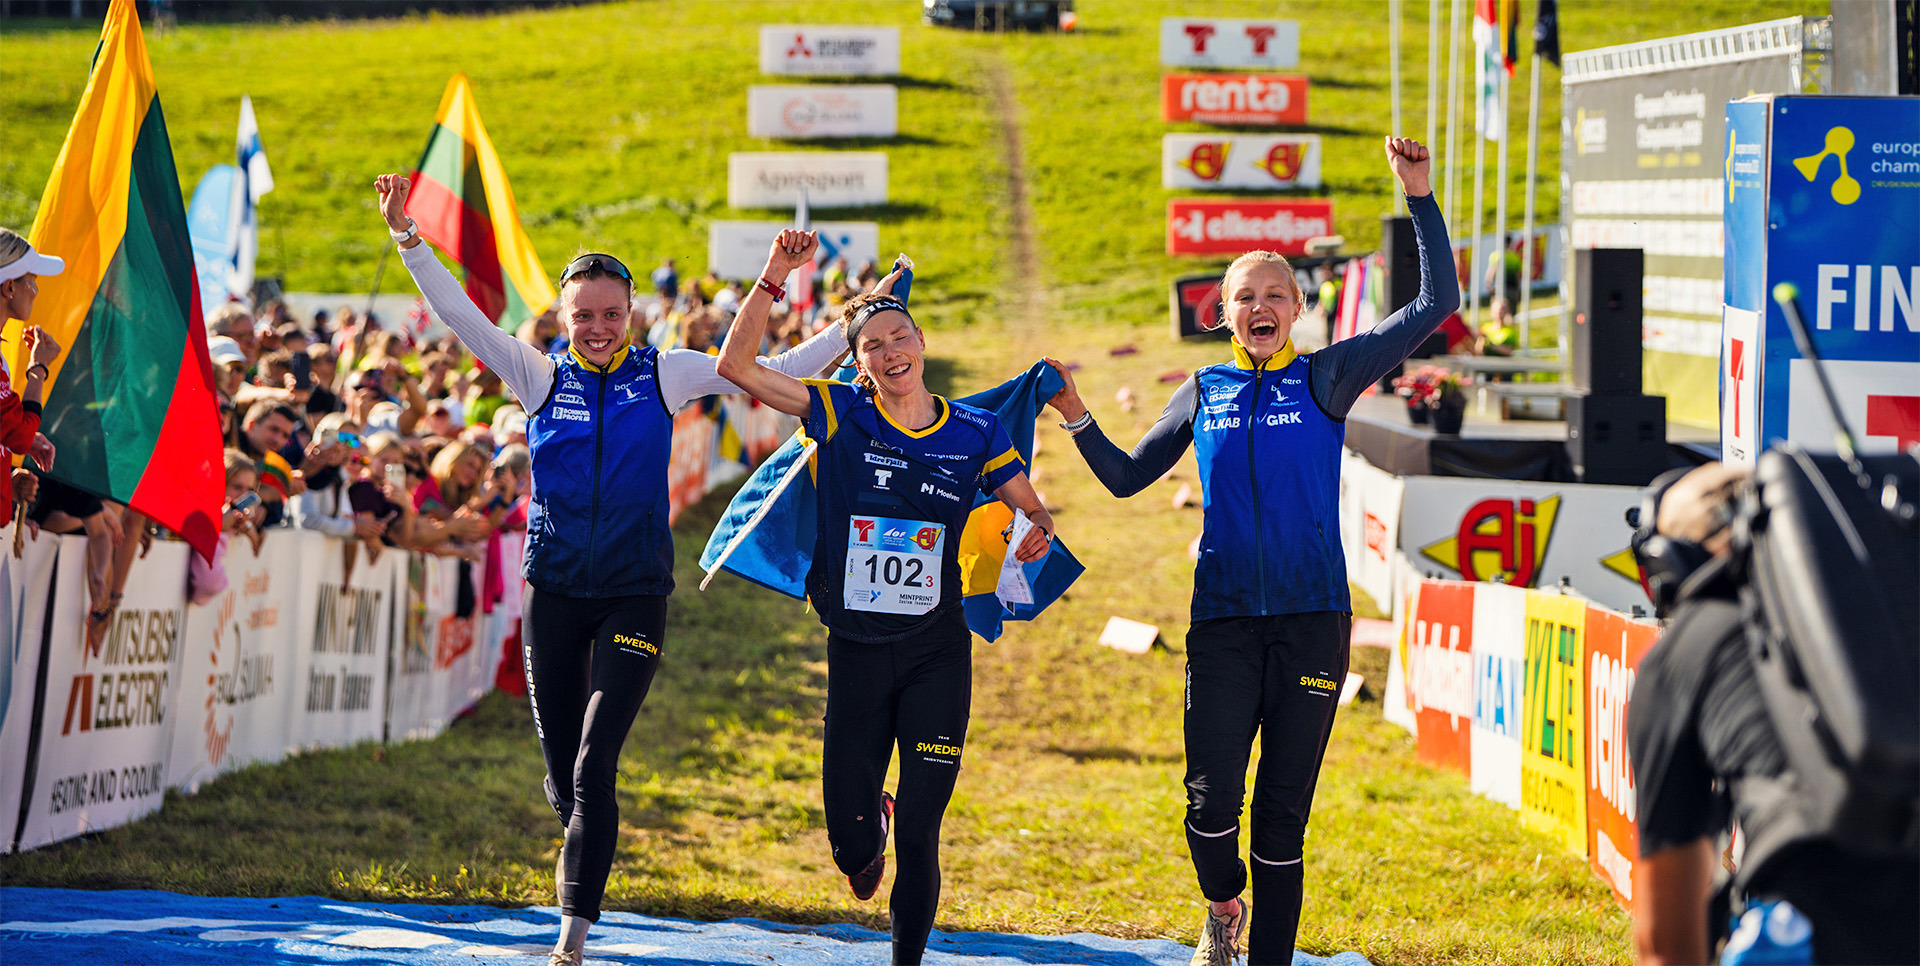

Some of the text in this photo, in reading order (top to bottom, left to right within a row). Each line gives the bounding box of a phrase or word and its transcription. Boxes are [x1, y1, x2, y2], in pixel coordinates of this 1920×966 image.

[1180, 79, 1290, 112] renta
[1871, 159, 1919, 173] cham
[1816, 264, 1920, 332] FIN
[955, 410, 988, 428] Folksam
[1211, 417, 1240, 430] LKAB
[1267, 411, 1302, 426] GRK
[865, 554, 923, 587] 102
[925, 576, 933, 587] 3
[899, 594, 933, 602] MINTPRINT
[613, 634, 658, 655] SWEDEN
[1300, 676, 1337, 691] SWEDEN
[94, 670, 168, 731] ELECTRIC
[916, 742, 962, 756] SWEDEN
[88, 768, 118, 805] AND
